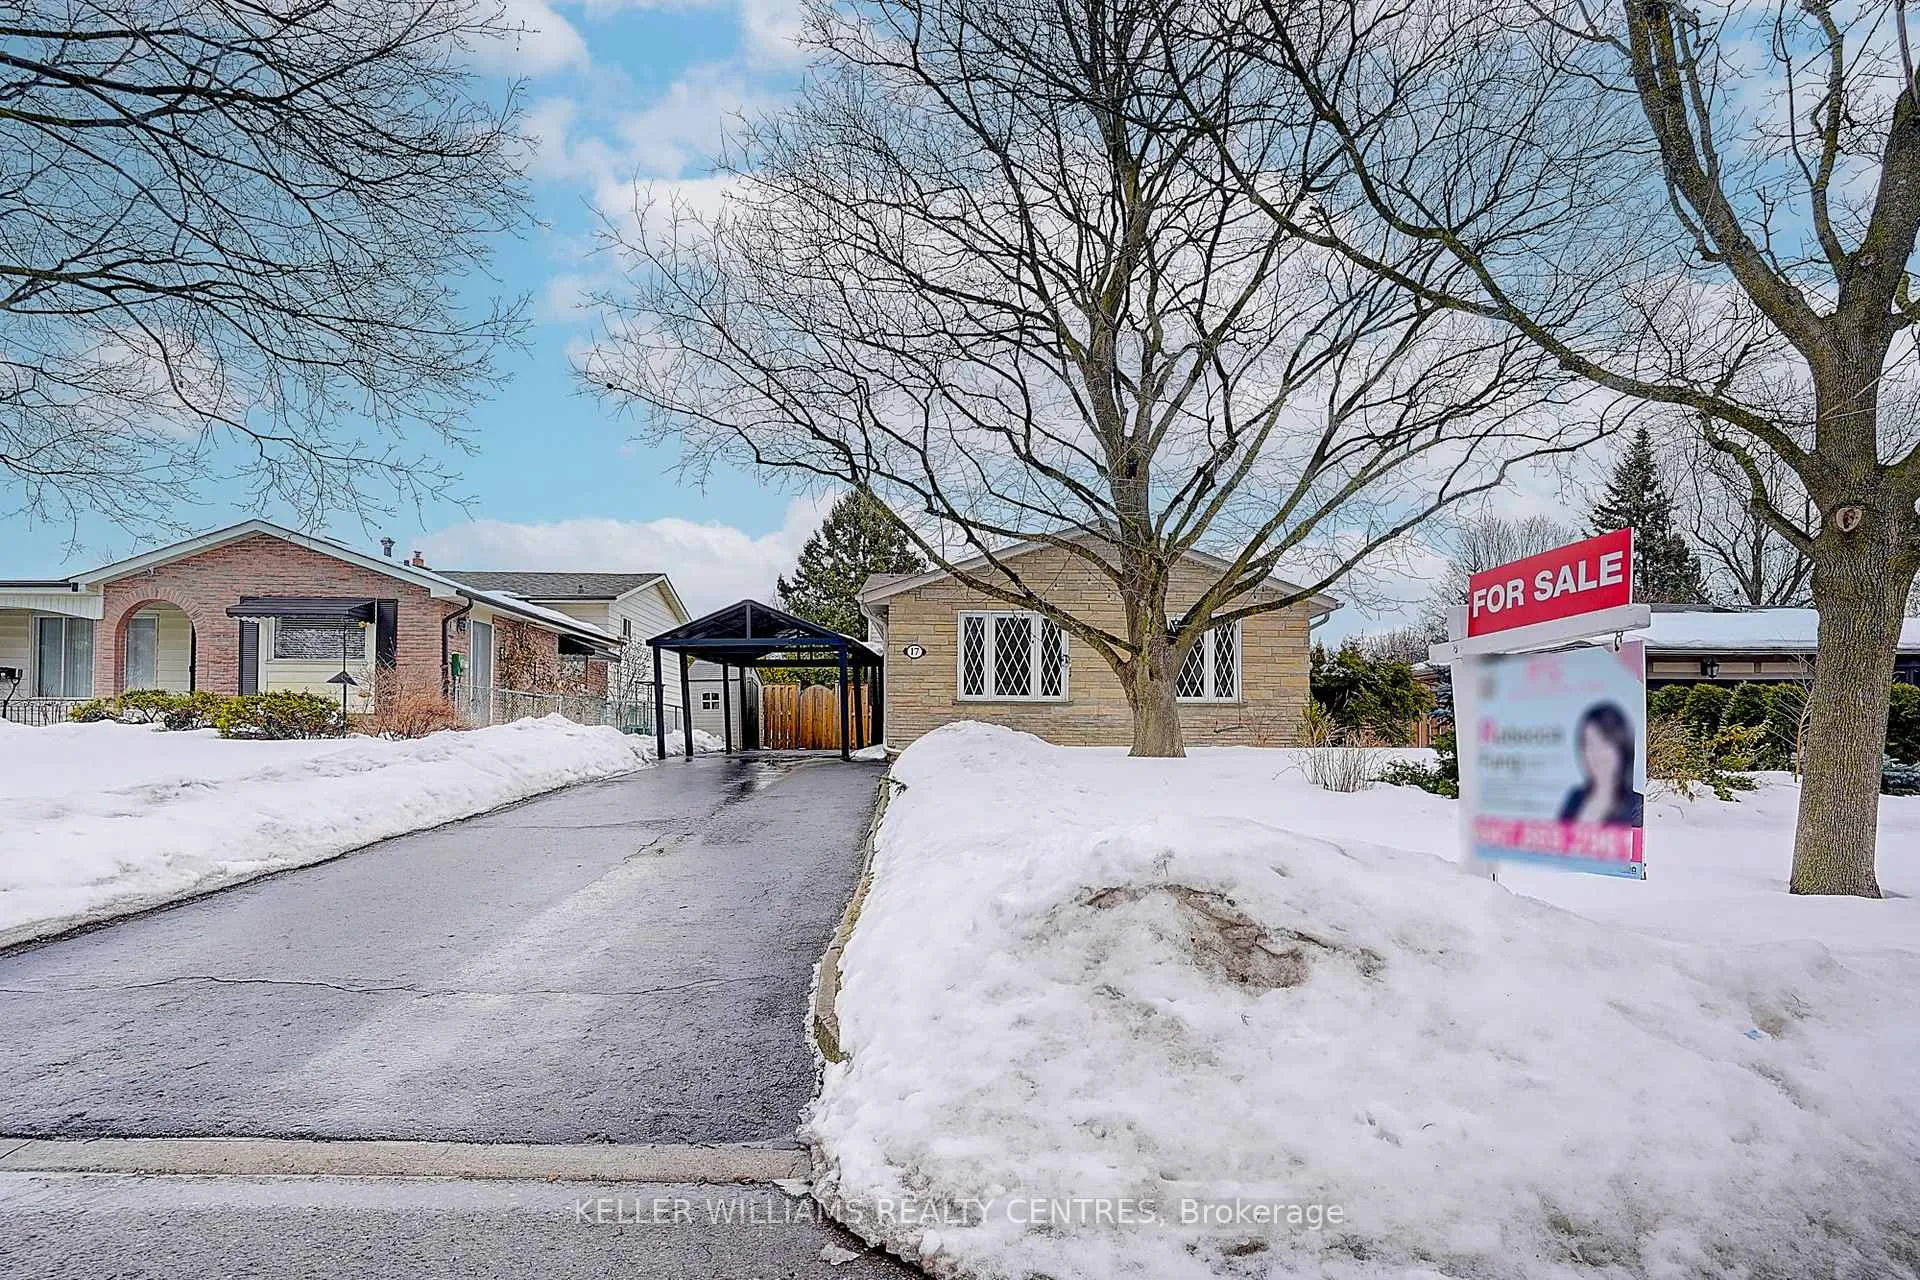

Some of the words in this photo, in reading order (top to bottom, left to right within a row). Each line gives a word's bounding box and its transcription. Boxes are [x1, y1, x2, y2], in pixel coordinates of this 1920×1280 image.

[1472, 578, 1525, 619] FOR
[1534, 551, 1624, 601] SALE
[910, 647, 920, 656] 17
